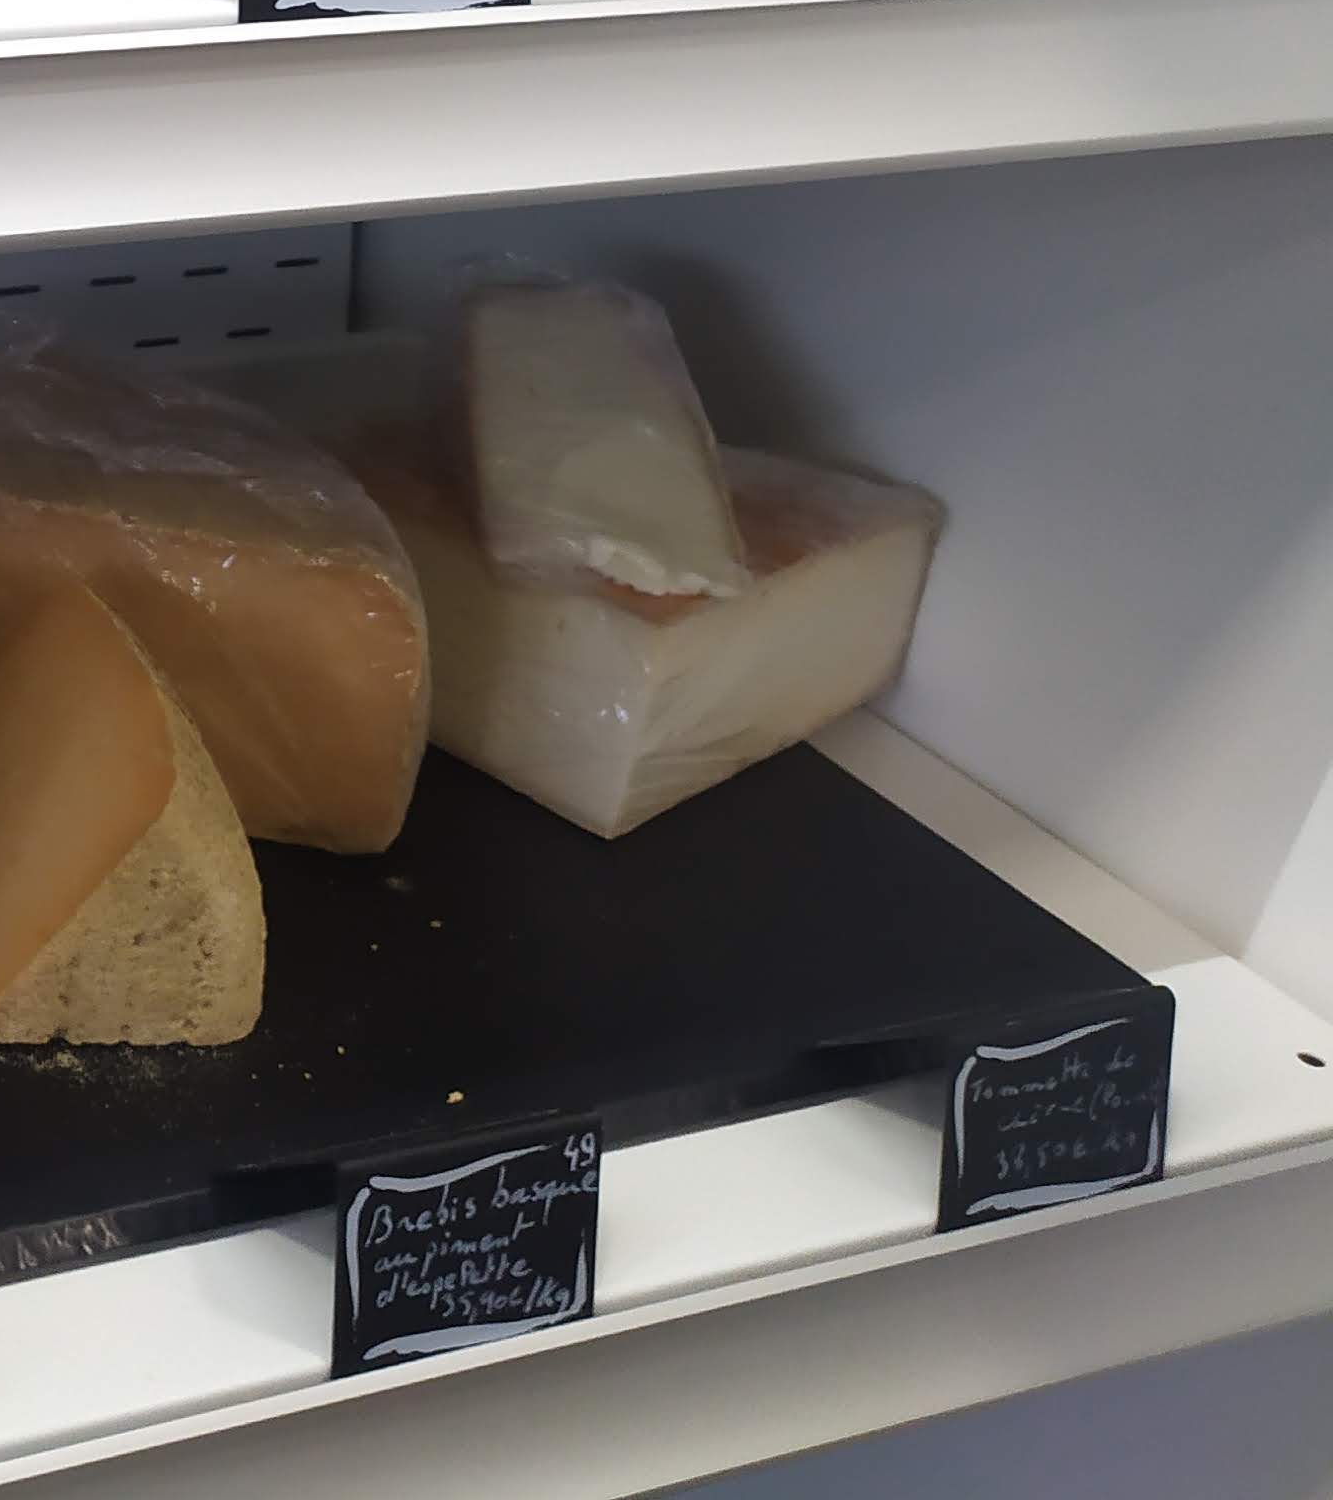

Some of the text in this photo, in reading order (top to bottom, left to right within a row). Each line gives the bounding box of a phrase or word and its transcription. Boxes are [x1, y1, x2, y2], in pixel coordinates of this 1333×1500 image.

[562, 1131, 597, 1171] 49
[364, 1181, 478, 1249] Brebis
[373, 1253, 419, 1273] au
